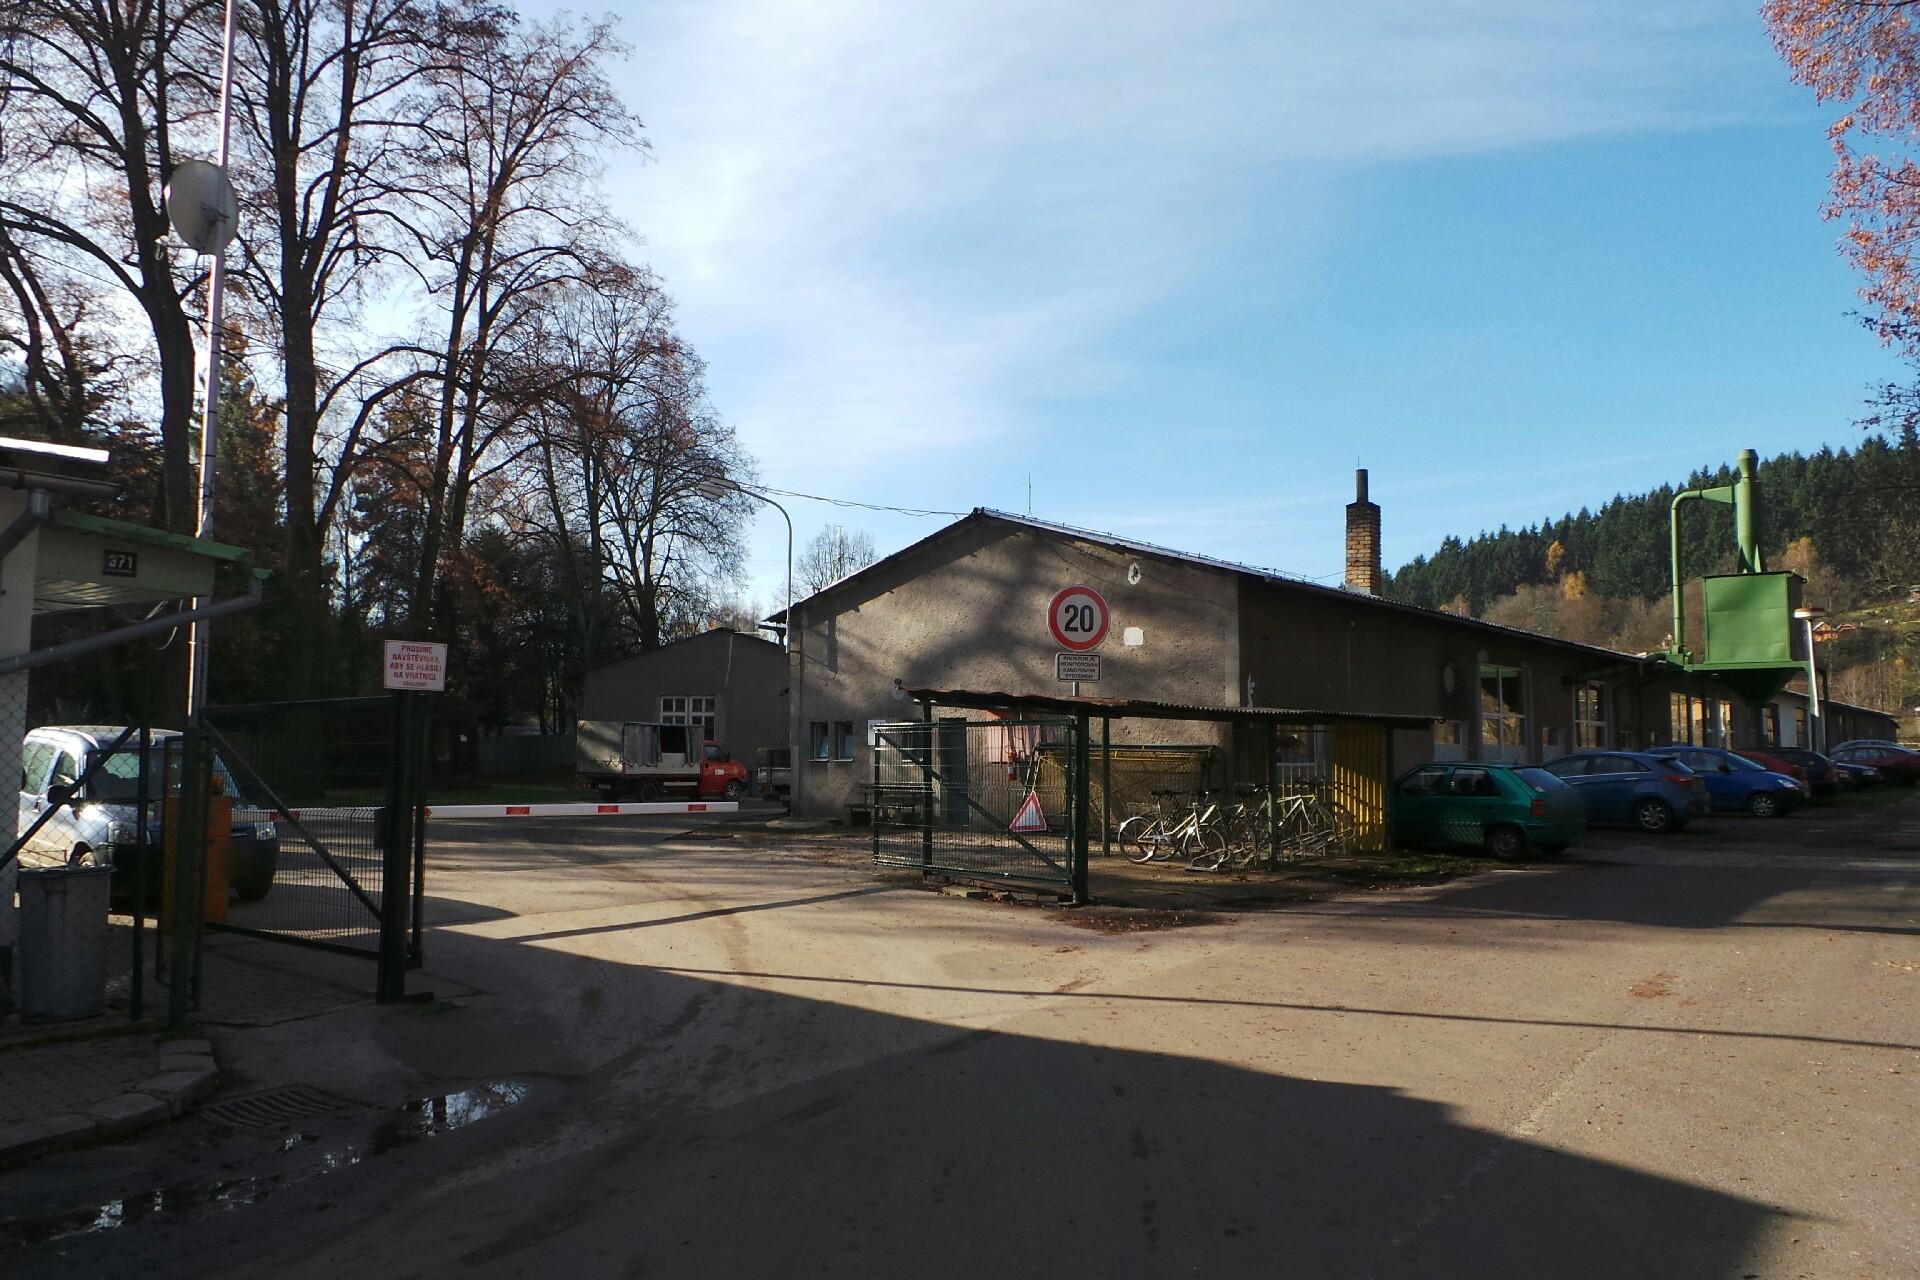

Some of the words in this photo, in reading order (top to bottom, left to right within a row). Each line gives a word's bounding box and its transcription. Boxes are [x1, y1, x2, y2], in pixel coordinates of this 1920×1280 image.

[109, 554, 133, 569] 371
[1064, 604, 1094, 633] 20
[390, 662, 404, 670] ABY
[406, 663, 415, 671] SE
